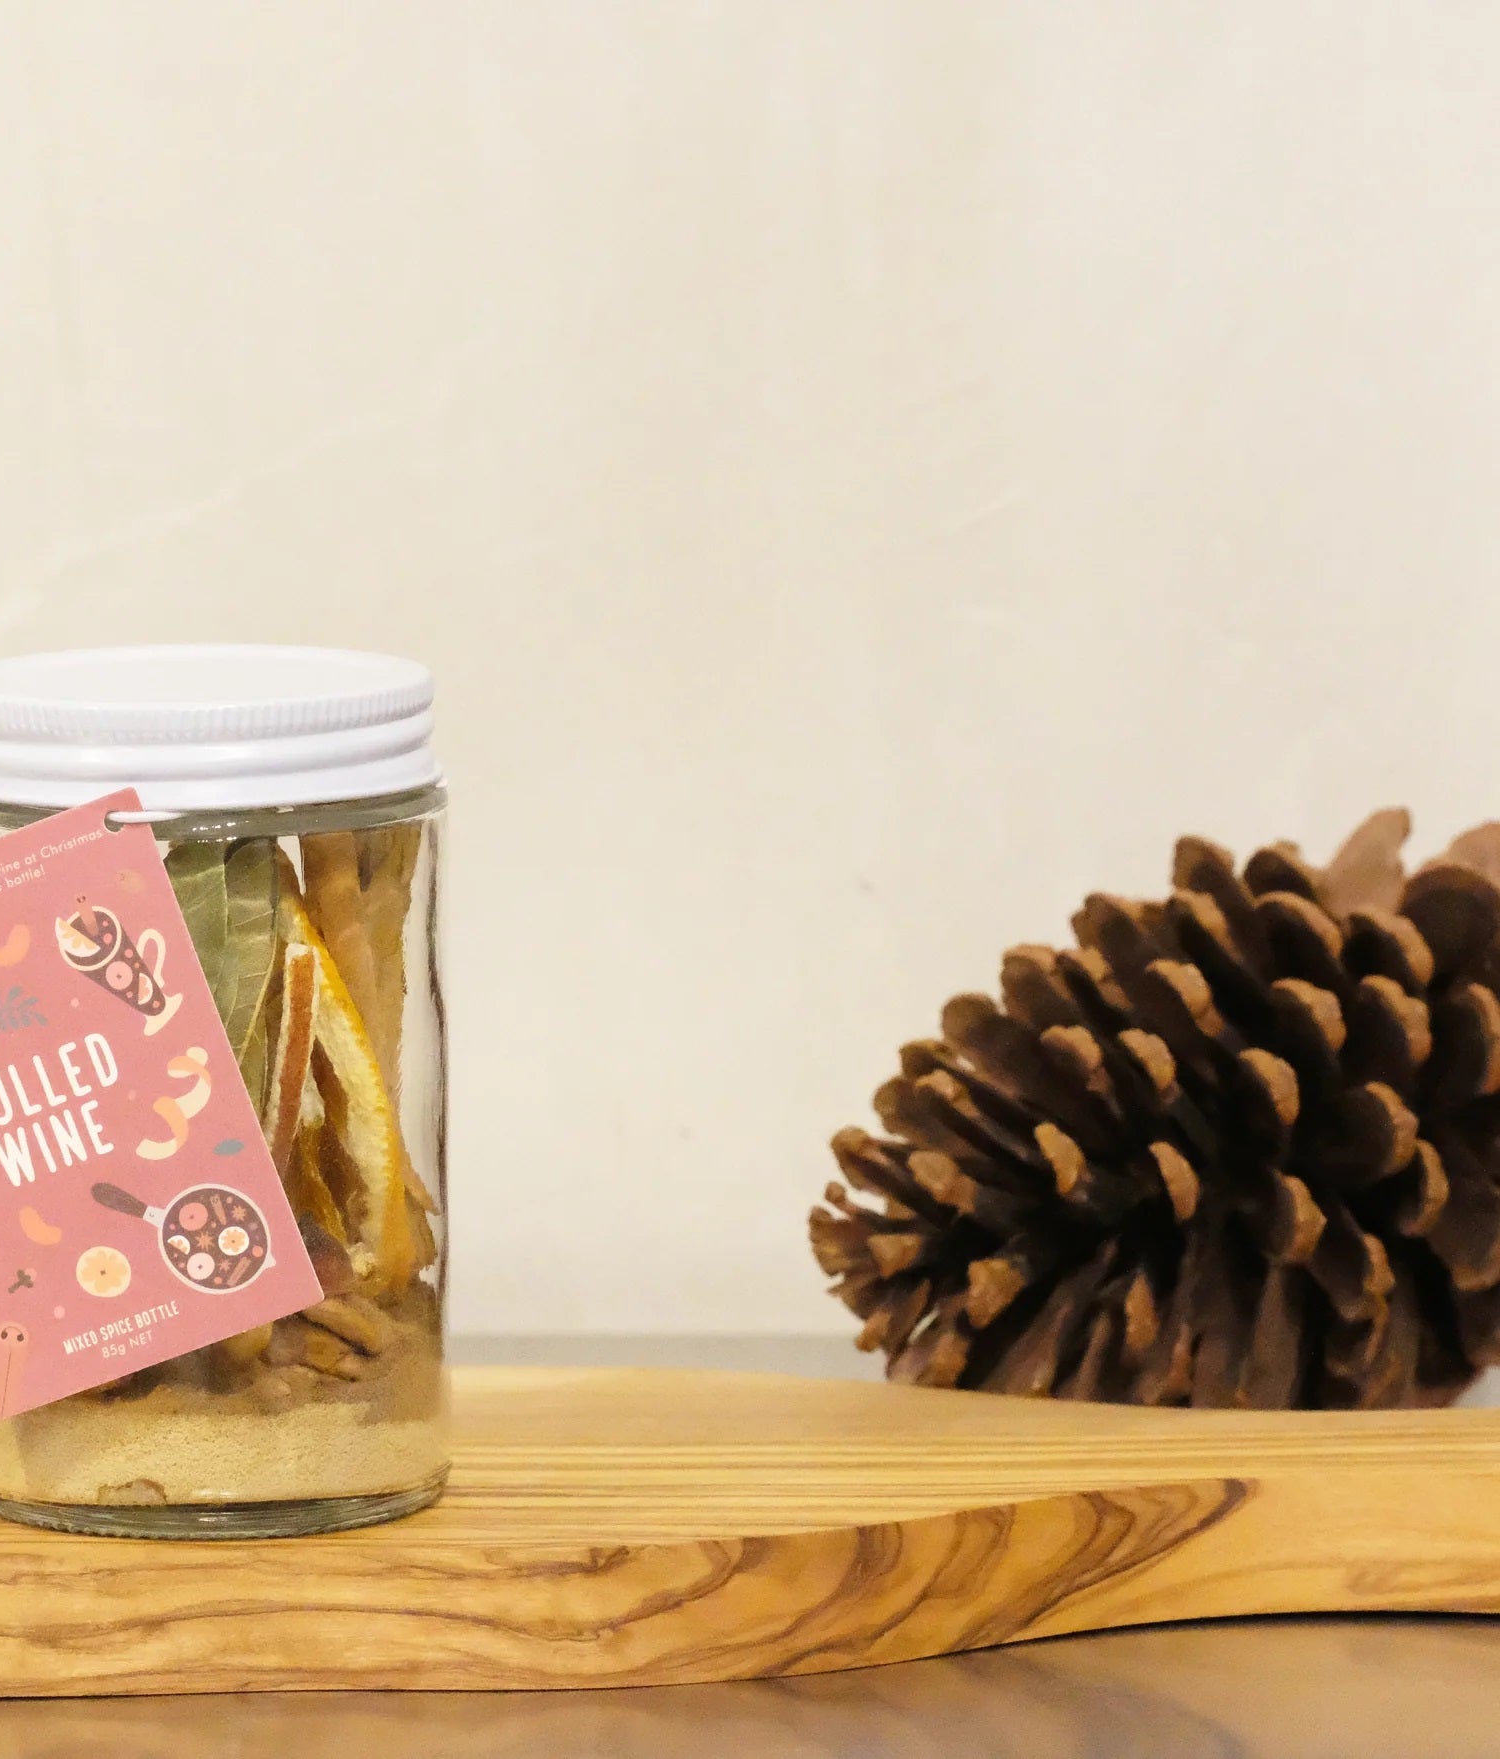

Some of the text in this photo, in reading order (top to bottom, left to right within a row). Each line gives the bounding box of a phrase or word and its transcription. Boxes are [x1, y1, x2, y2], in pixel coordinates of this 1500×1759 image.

[24, 854, 37, 865] at
[40, 829, 104, 858] Christmas
[5, 863, 46, 888] bottle!
[62, 1300, 180, 1355] MIXED SPICE BOTTLE
[101, 1330, 153, 1358] 85g NET
